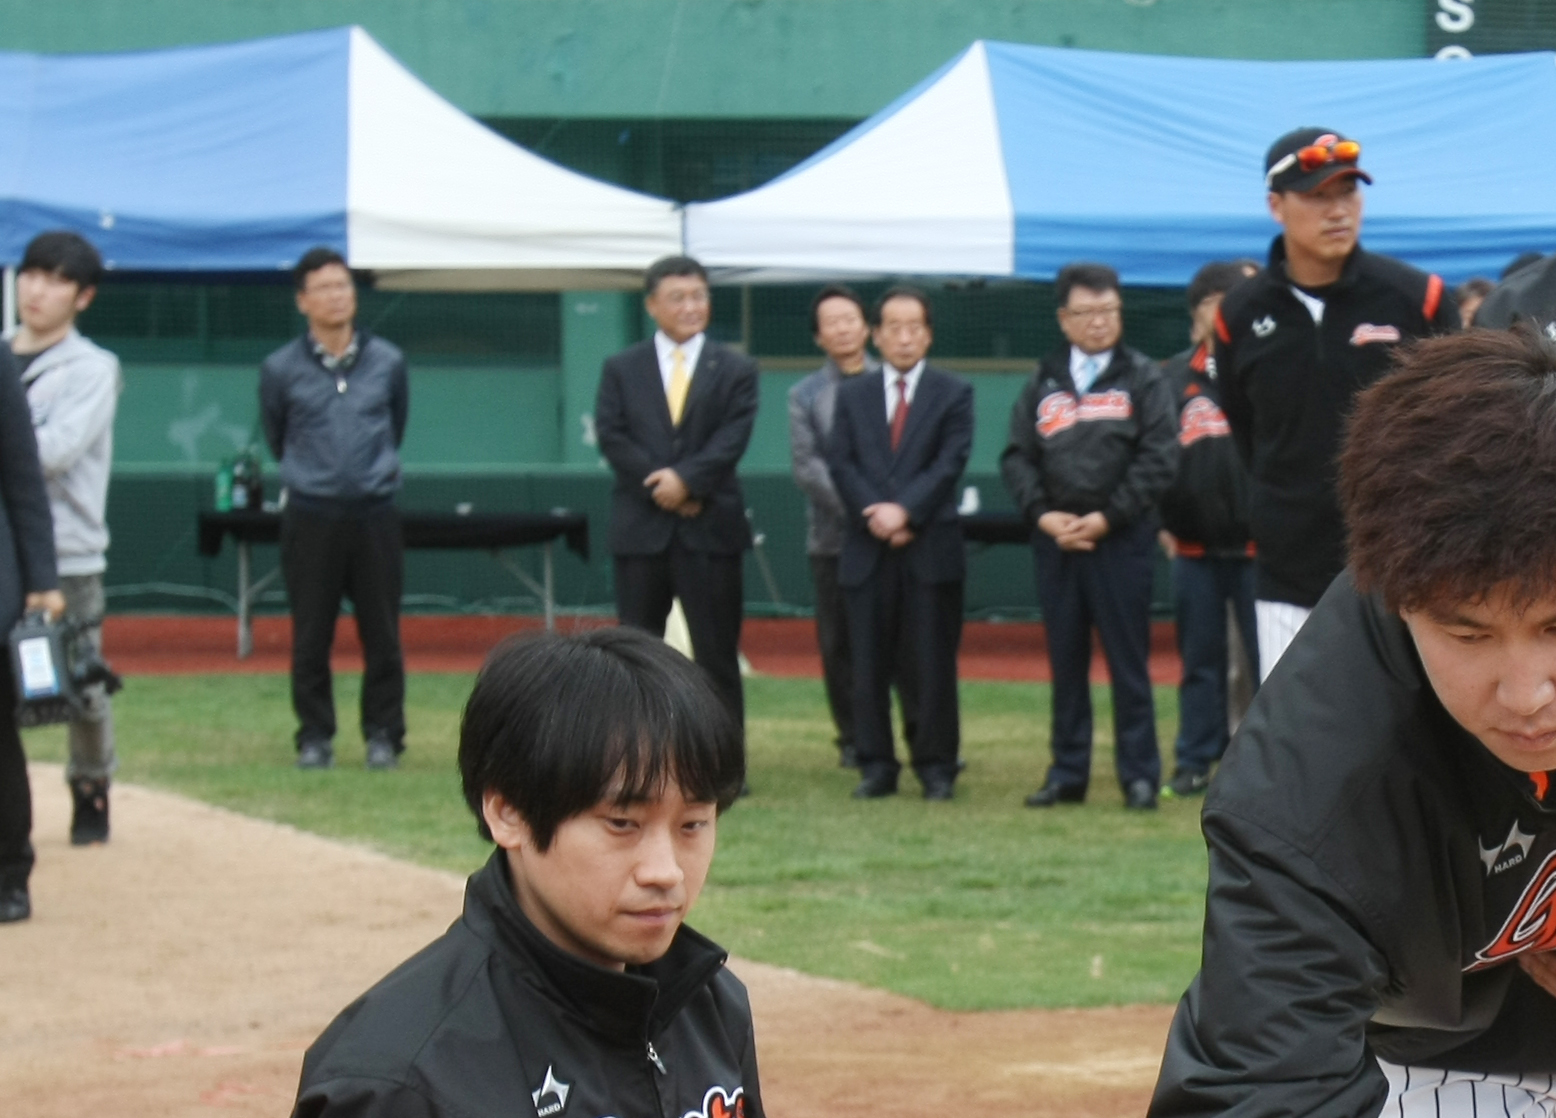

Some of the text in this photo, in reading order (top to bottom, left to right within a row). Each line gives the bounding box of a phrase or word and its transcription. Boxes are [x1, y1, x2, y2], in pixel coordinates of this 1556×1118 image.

[1436, 0, 1475, 33] S
[1494, 854, 1522, 874] HARD
[537, 1102, 561, 1118] HARD
